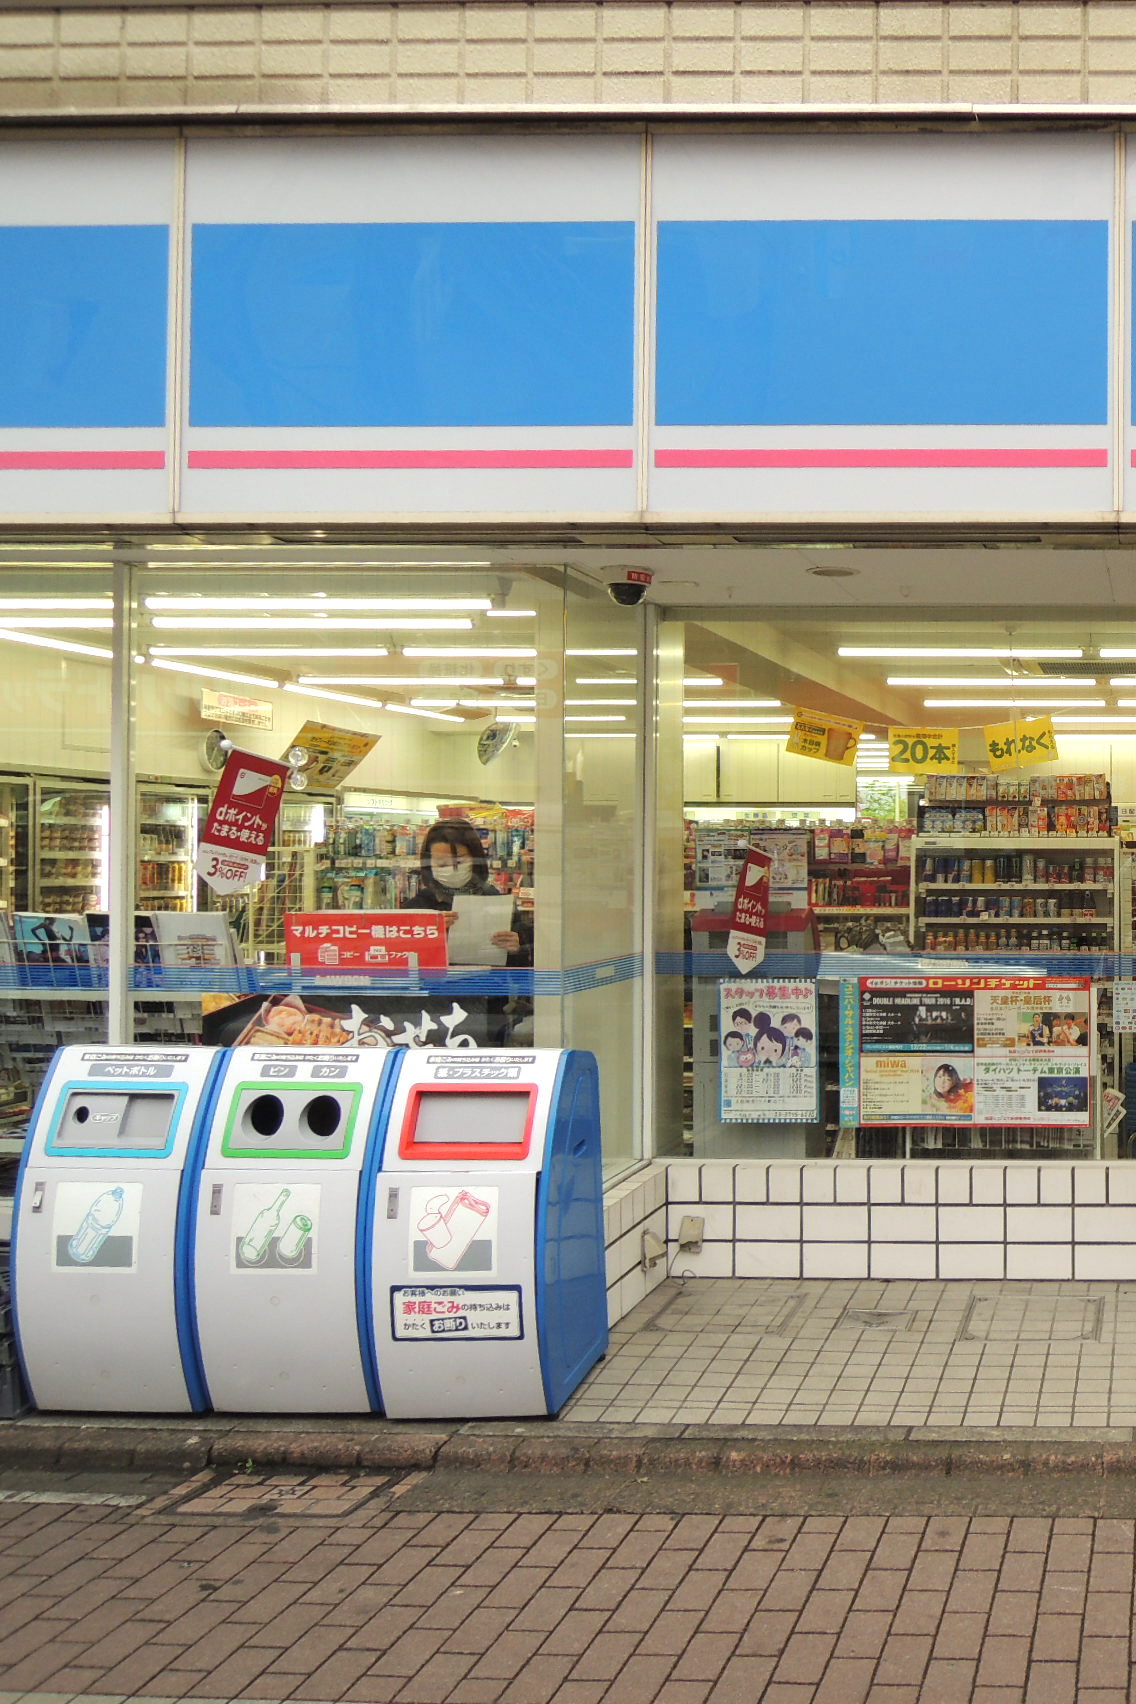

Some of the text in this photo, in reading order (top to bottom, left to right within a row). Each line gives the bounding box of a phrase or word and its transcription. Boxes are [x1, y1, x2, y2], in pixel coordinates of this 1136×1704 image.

[989, 730, 1050, 759] もれなく
[891, 739, 951, 764] 20本
[216, 804, 268, 831] dポイントが
[207, 857, 248, 883] 3%OFF!
[290, 925, 440, 938] マルチコピー機はこちら
[928, 978, 1043, 988] ローソンチケット
[341, 1001, 478, 1048] おせち
[875, 1057, 907, 1068] miwa
[104, 1066, 157, 1076] ペットボトル
[319, 1066, 340, 1077] カン
[402, 1288, 465, 1297] お客様へのお願い
[402, 1301, 511, 1315] 家庭ごみの持ち込みは
[403, 1319, 427, 1330] かたく
[471, 1321, 511, 1330] いたします
